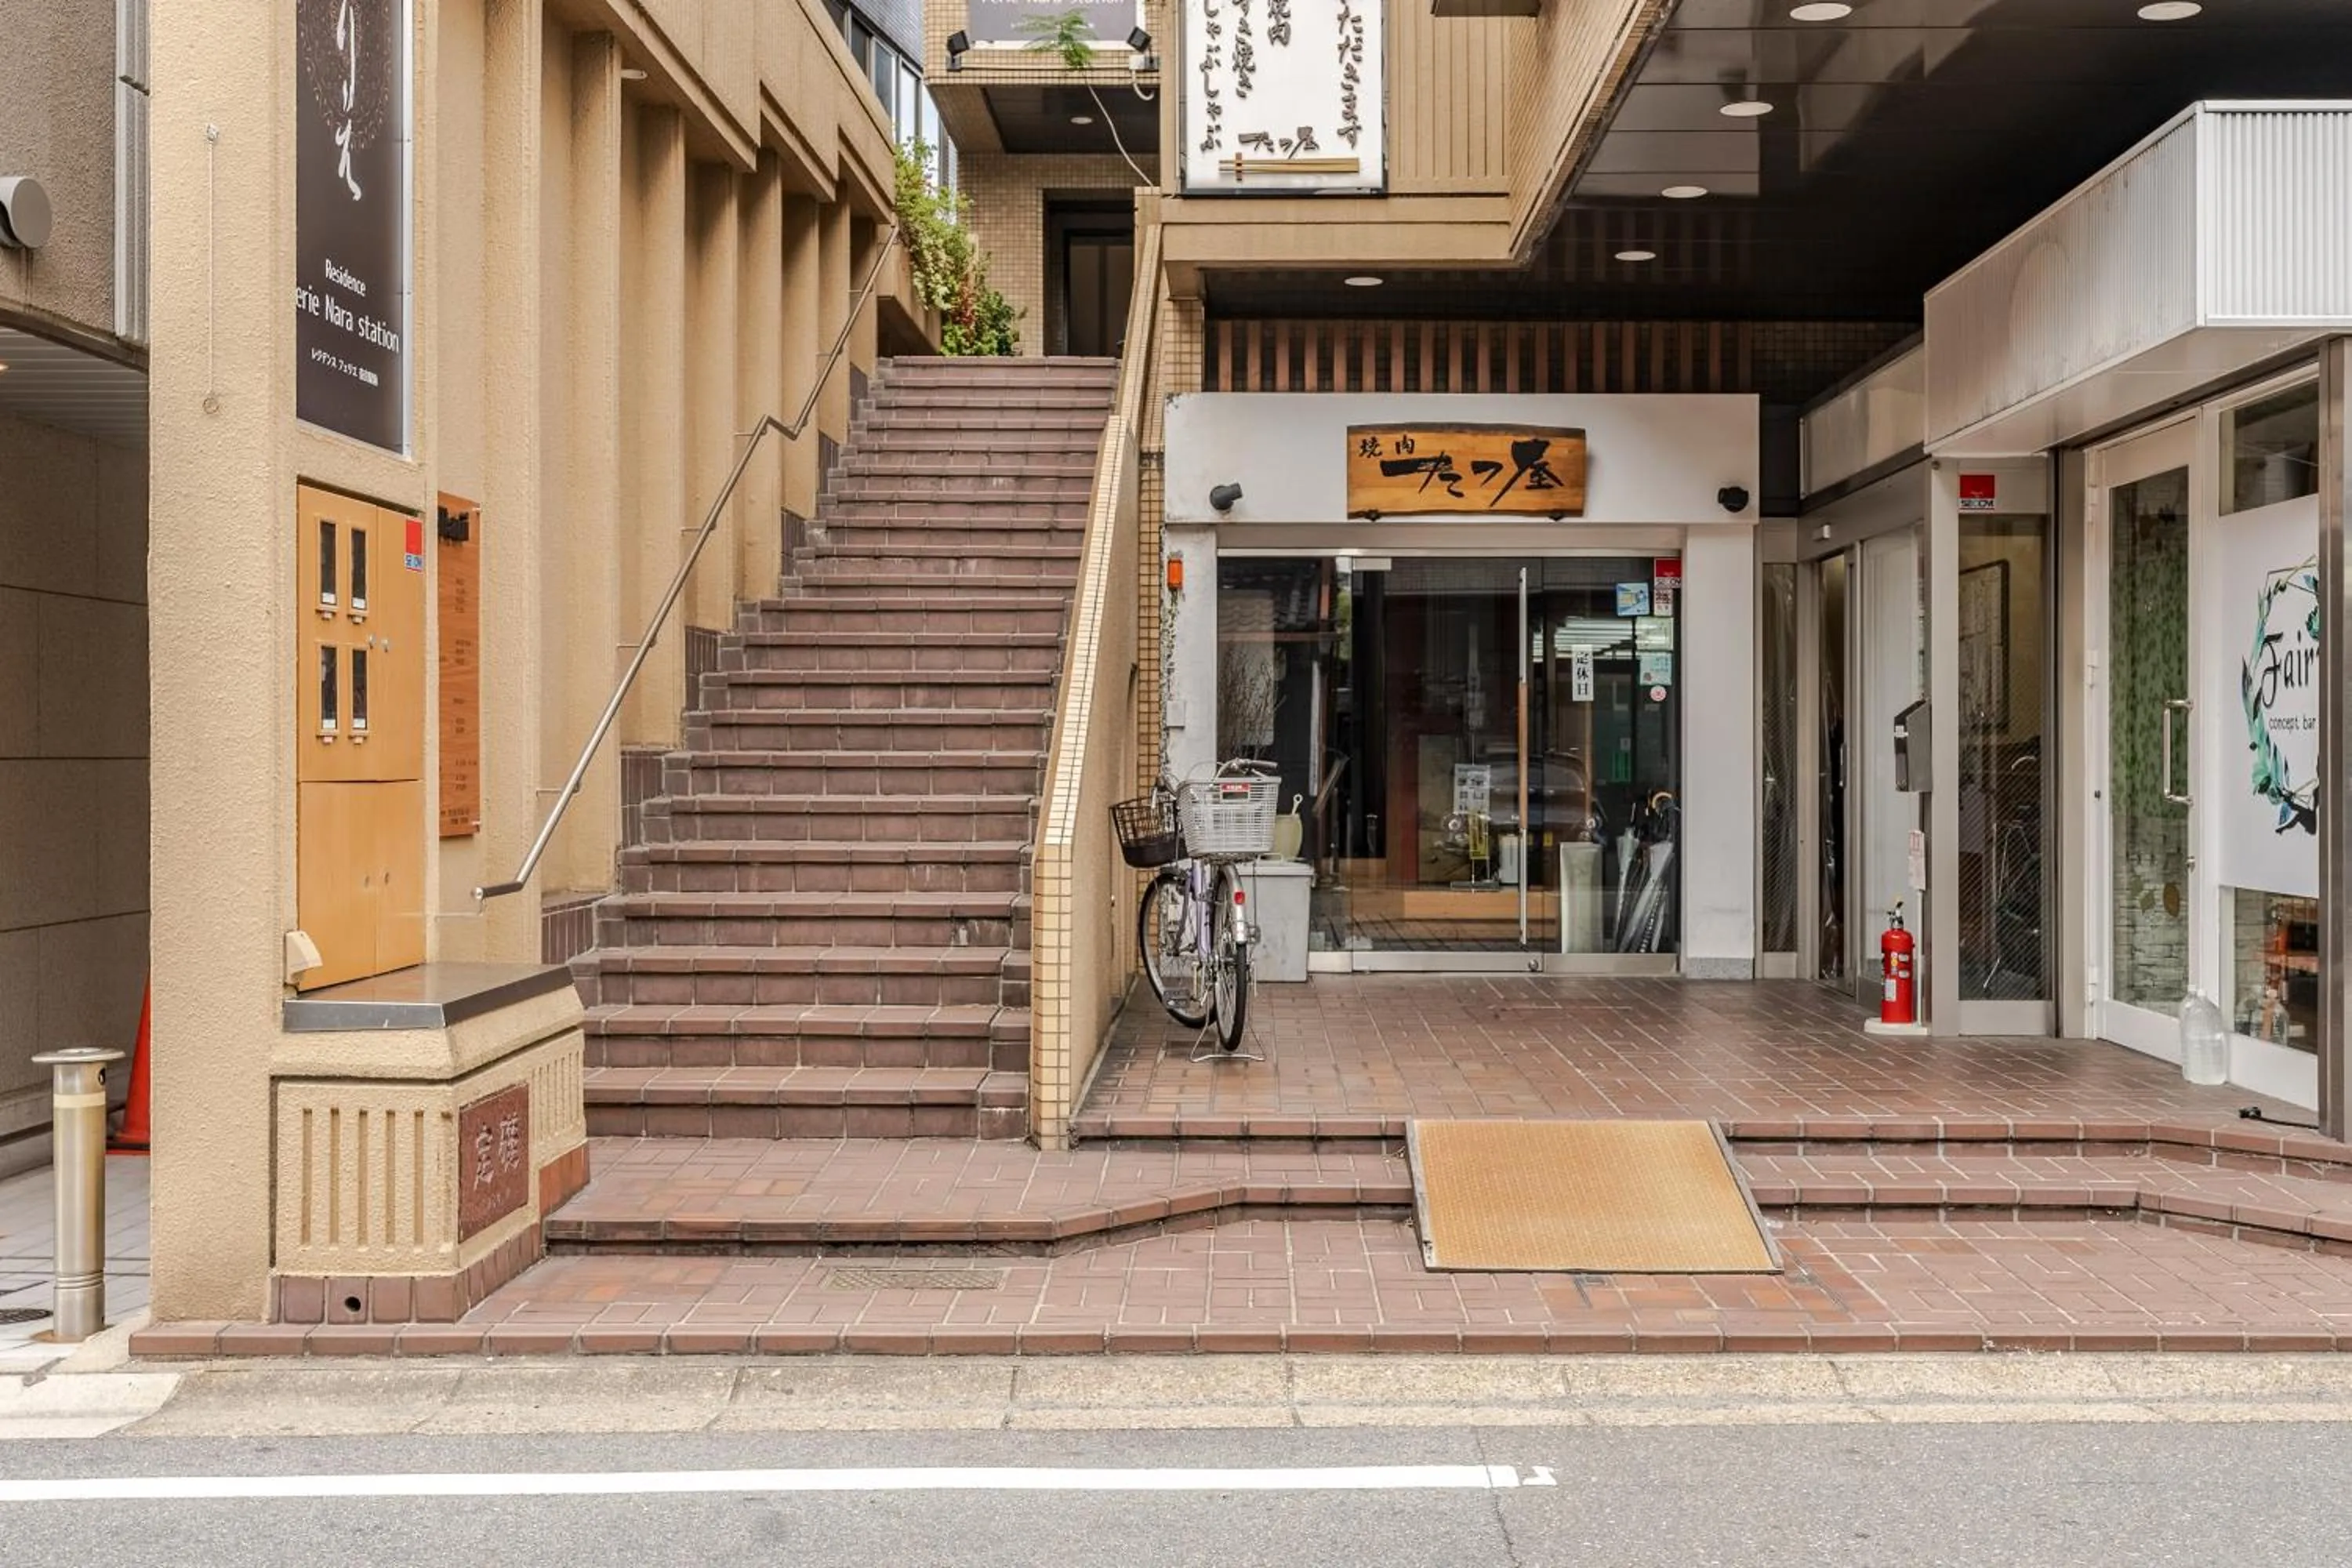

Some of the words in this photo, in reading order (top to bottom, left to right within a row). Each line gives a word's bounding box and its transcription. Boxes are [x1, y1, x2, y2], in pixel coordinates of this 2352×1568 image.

[1337, 0, 1366, 149] ただきます
[325, 258, 366, 297] Residence
[296, 285, 319, 316] erie
[325, 293, 354, 332] Nara
[358, 315, 399, 354] station
[1359, 434, 1415, 458] 焼肉
[1577, 652, 1590, 695] 定休日
[2260, 630, 2319, 708] Fair
[2269, 716, 2299, 733] concept
[2303, 715, 2317, 731] bar
